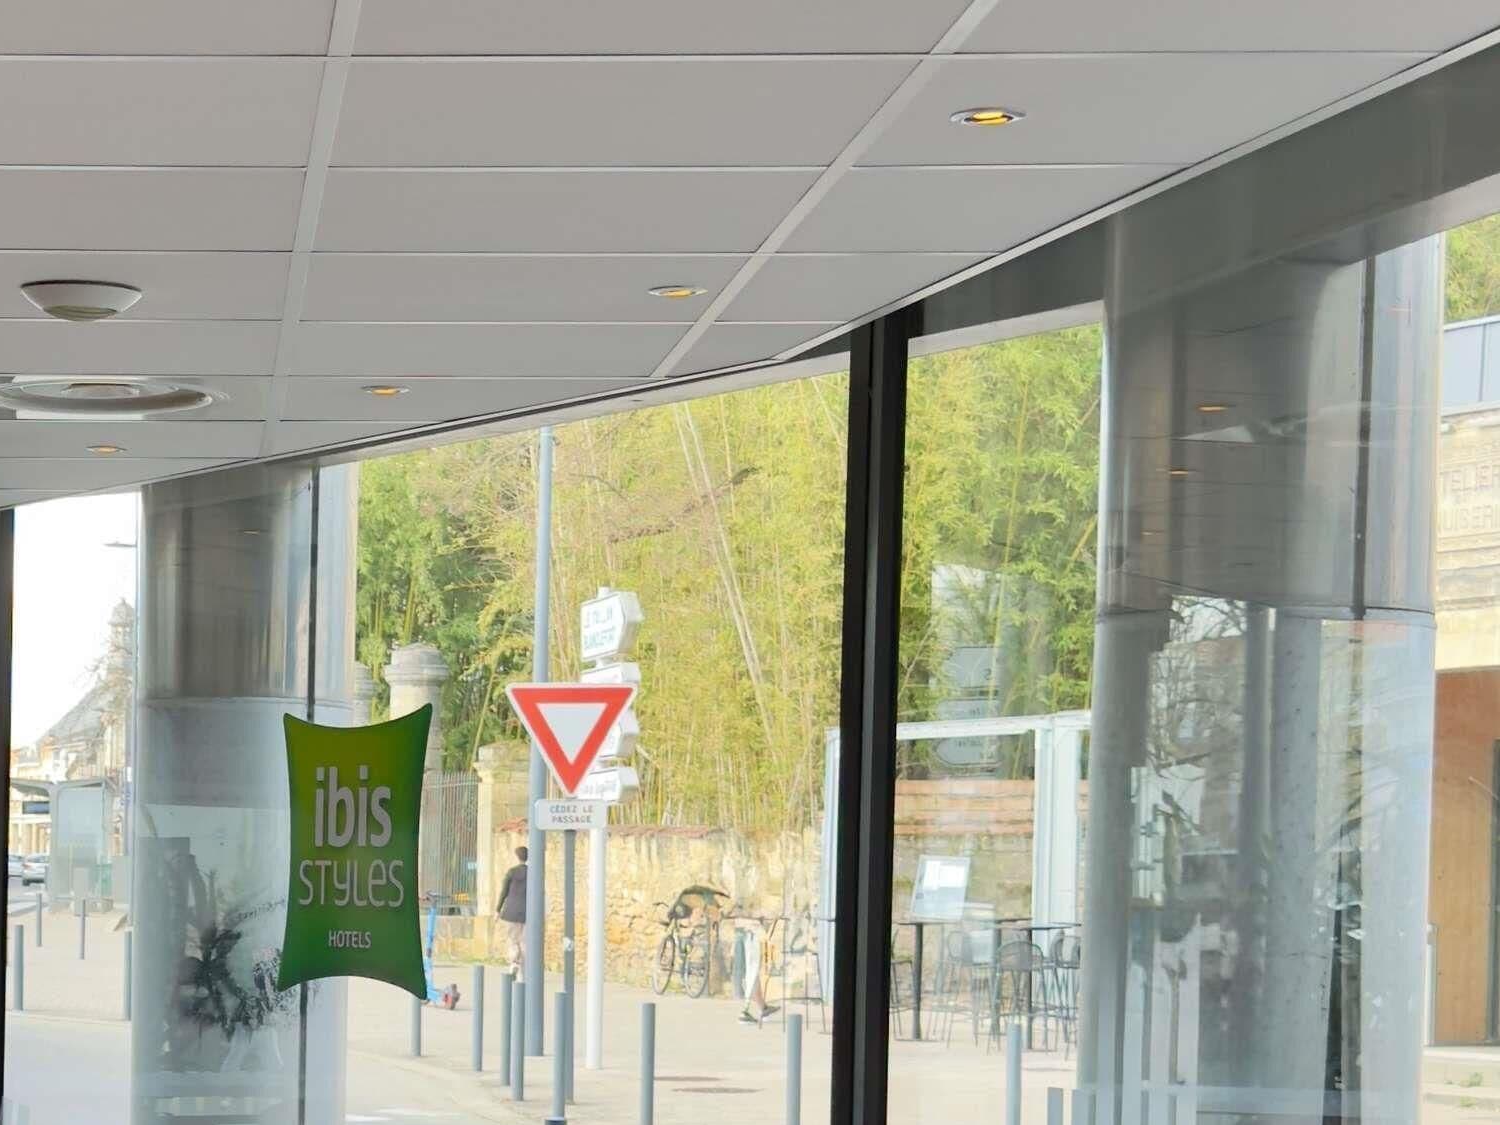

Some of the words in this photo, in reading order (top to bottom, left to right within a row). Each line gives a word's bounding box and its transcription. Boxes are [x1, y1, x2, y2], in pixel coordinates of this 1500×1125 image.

[314, 765, 392, 848] ibis
[582, 805, 593, 813] LE
[552, 815, 592, 824] PASSAGE
[329, 930, 372, 948] HOTELS
